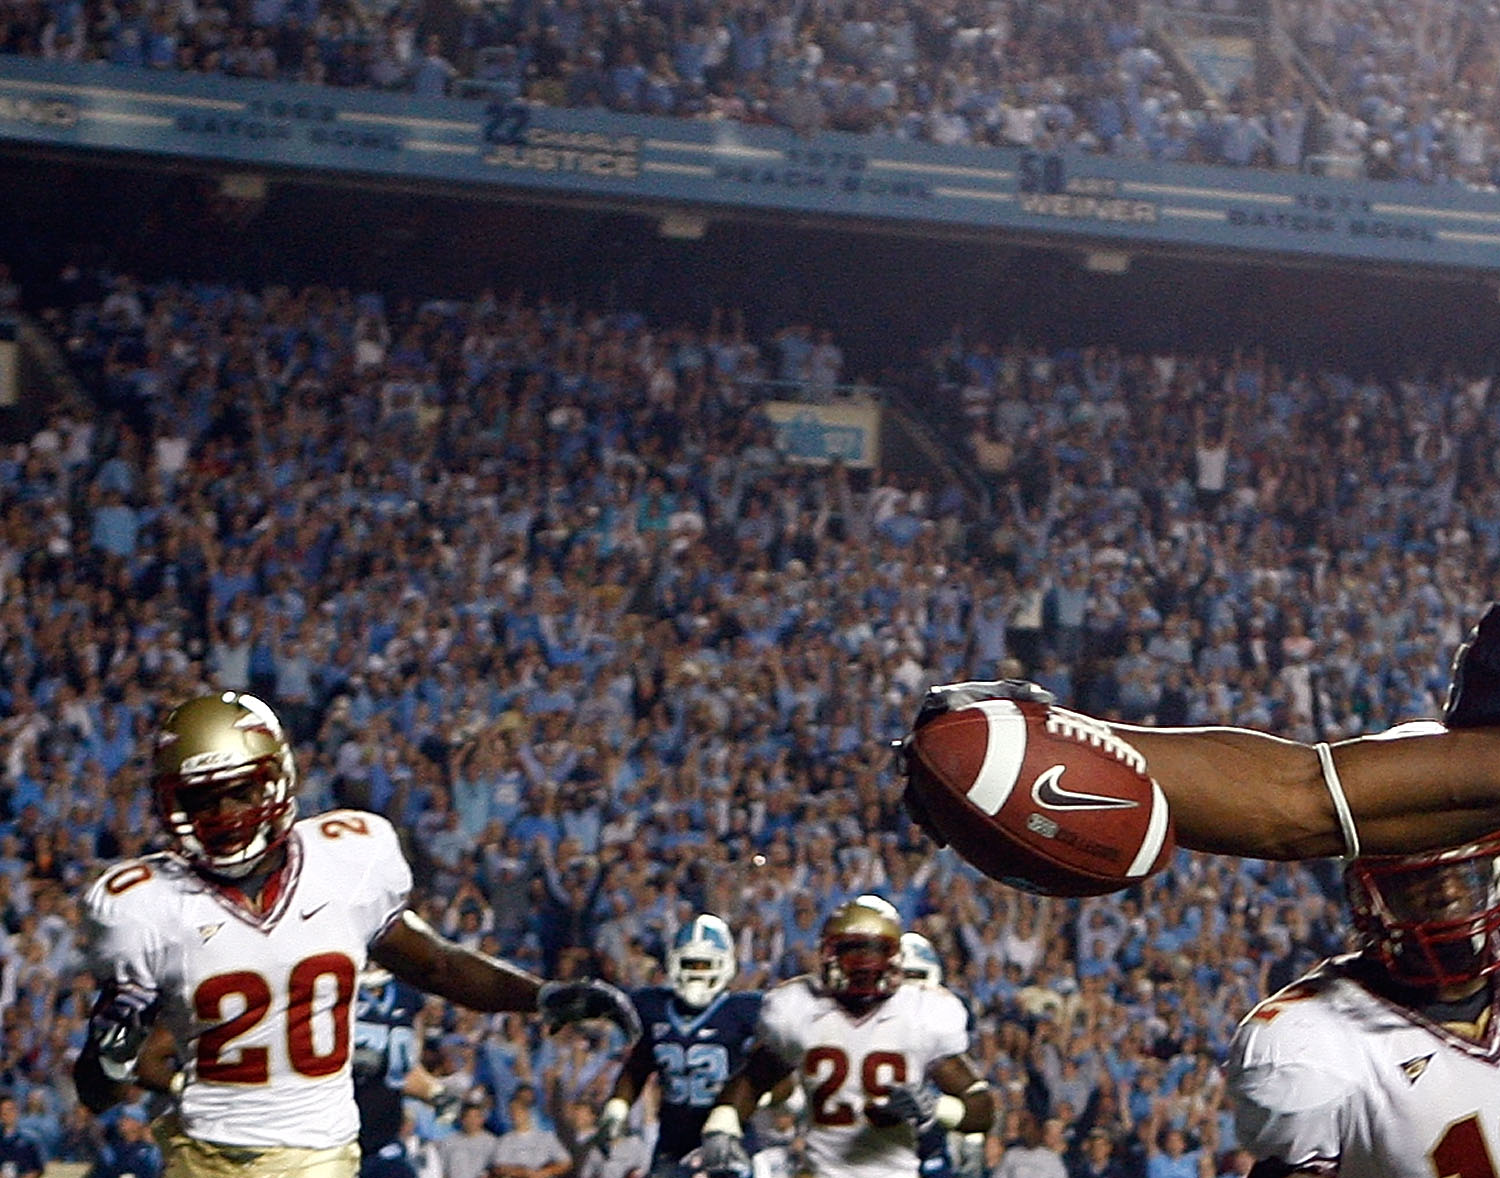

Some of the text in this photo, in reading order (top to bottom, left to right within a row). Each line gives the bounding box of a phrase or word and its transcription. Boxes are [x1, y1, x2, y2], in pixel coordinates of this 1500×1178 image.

[485, 103, 530, 145] 22
[484, 145, 638, 177] JUSTICE
[1020, 192, 1157, 222] WEINER
[193, 951, 357, 1087] 20
